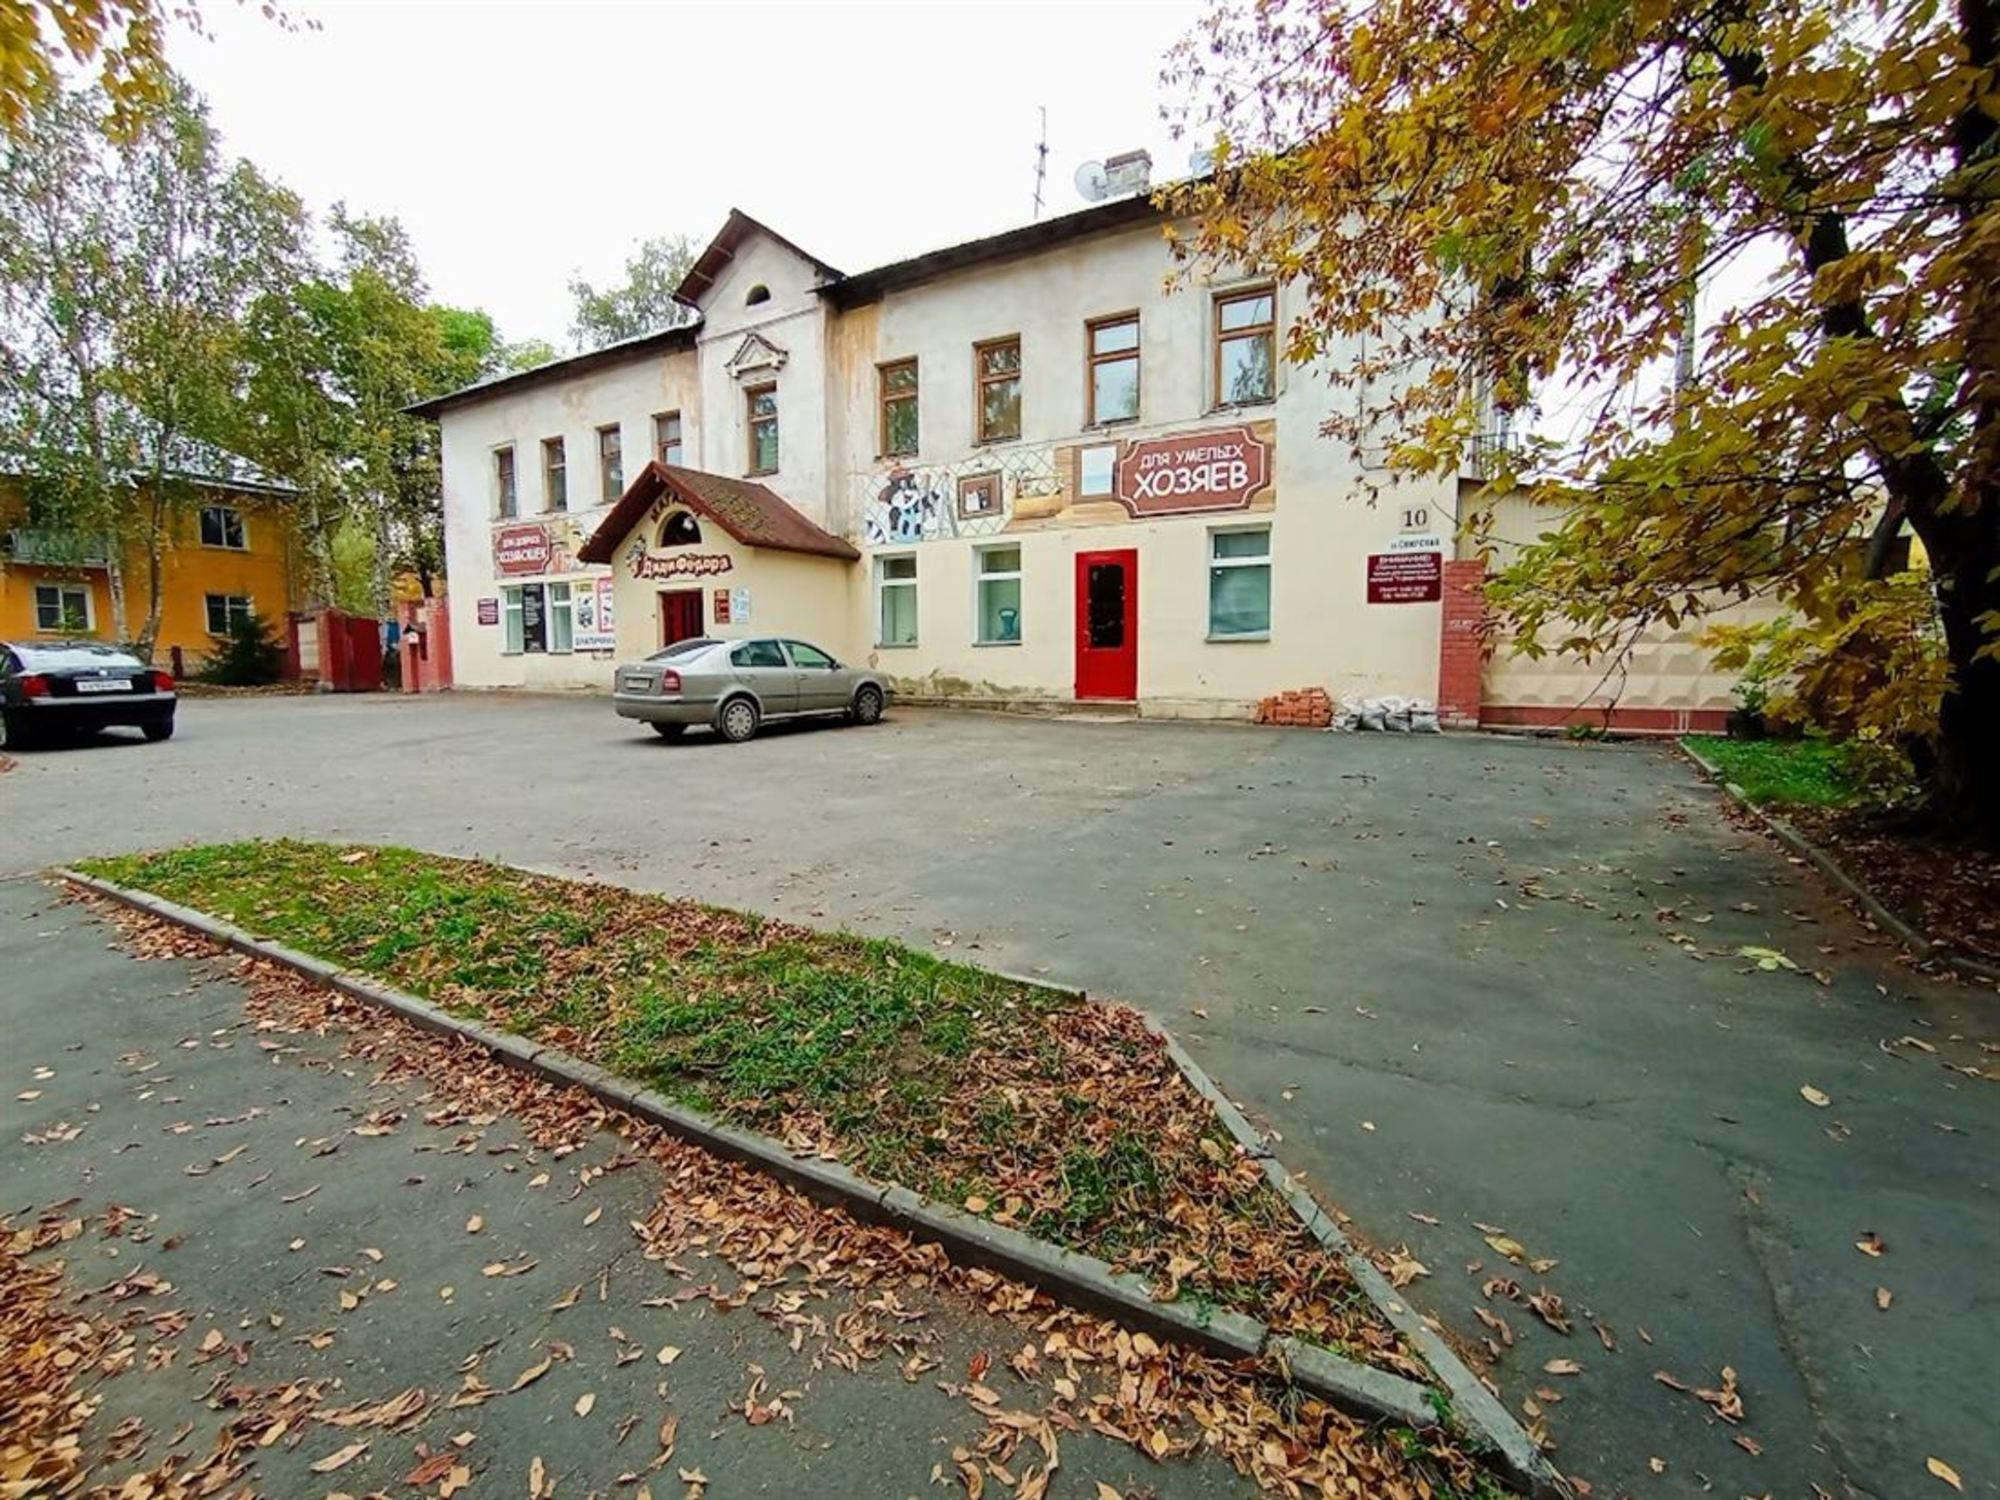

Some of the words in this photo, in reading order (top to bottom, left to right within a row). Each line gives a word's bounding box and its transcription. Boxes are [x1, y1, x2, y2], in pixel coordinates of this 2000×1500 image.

[1140, 453, 1171, 470] ДЛЯ
[1174, 443, 1243, 465] УМЕЛЫХ
[1132, 460, 1250, 500] ХОЗЯЕВ
[1402, 508, 1429, 527] 10
